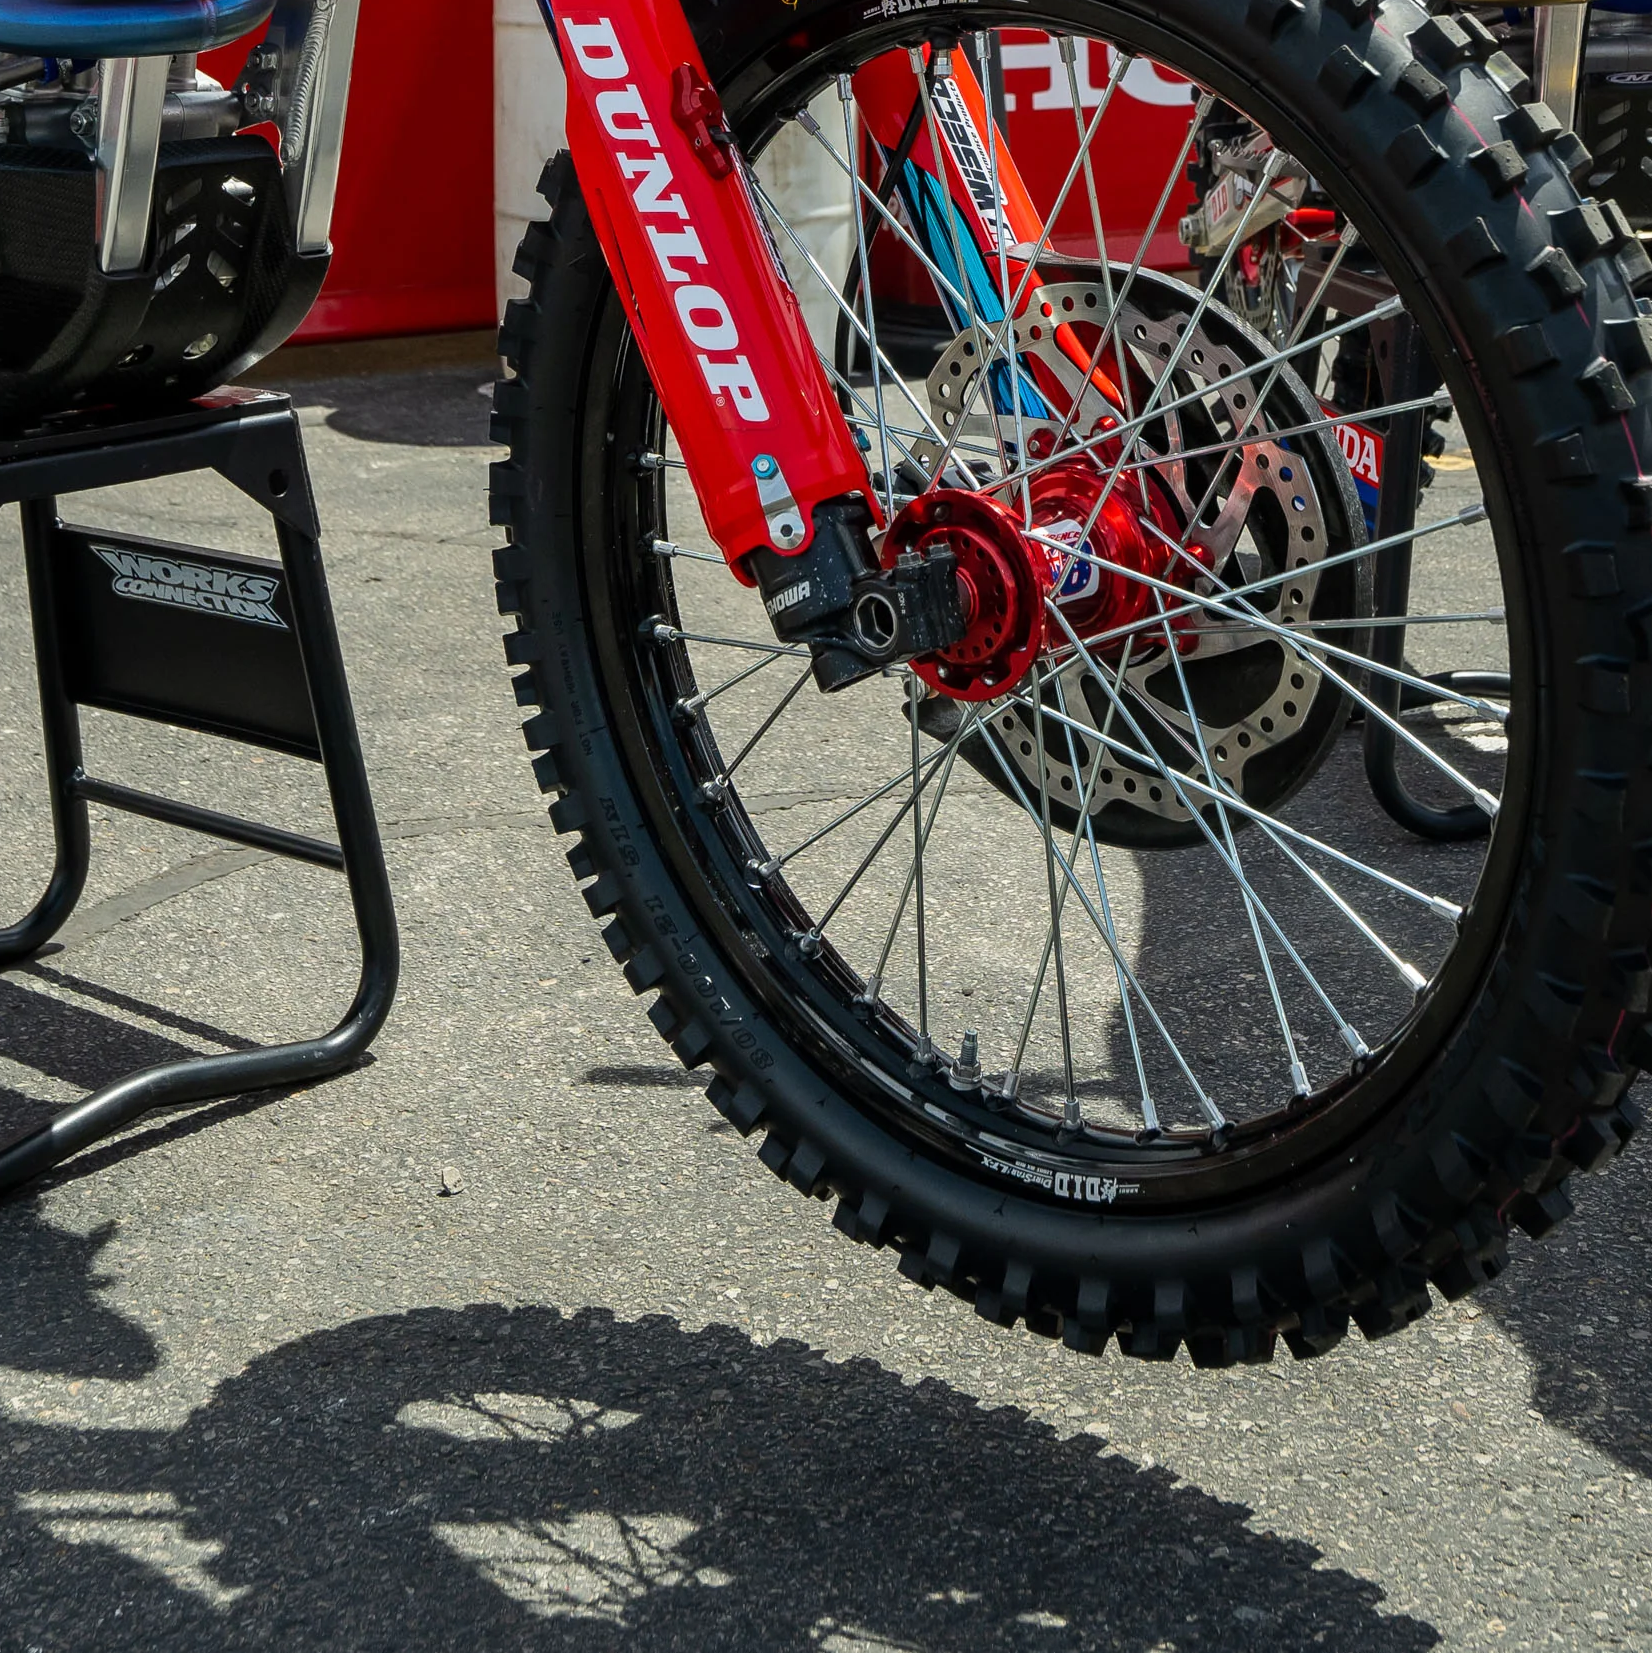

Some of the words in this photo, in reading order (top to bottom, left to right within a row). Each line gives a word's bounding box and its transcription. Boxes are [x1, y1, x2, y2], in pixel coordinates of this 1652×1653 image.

[562, 16, 770, 423] DUNLOP
[1337, 418, 1380, 483] NDA
[104, 551, 277, 600] WORKS
[766, 580, 811, 618] SHOWA
[114, 576, 283, 624] CONNECTION
[1054, 1171, 1101, 1202] D.I.D
